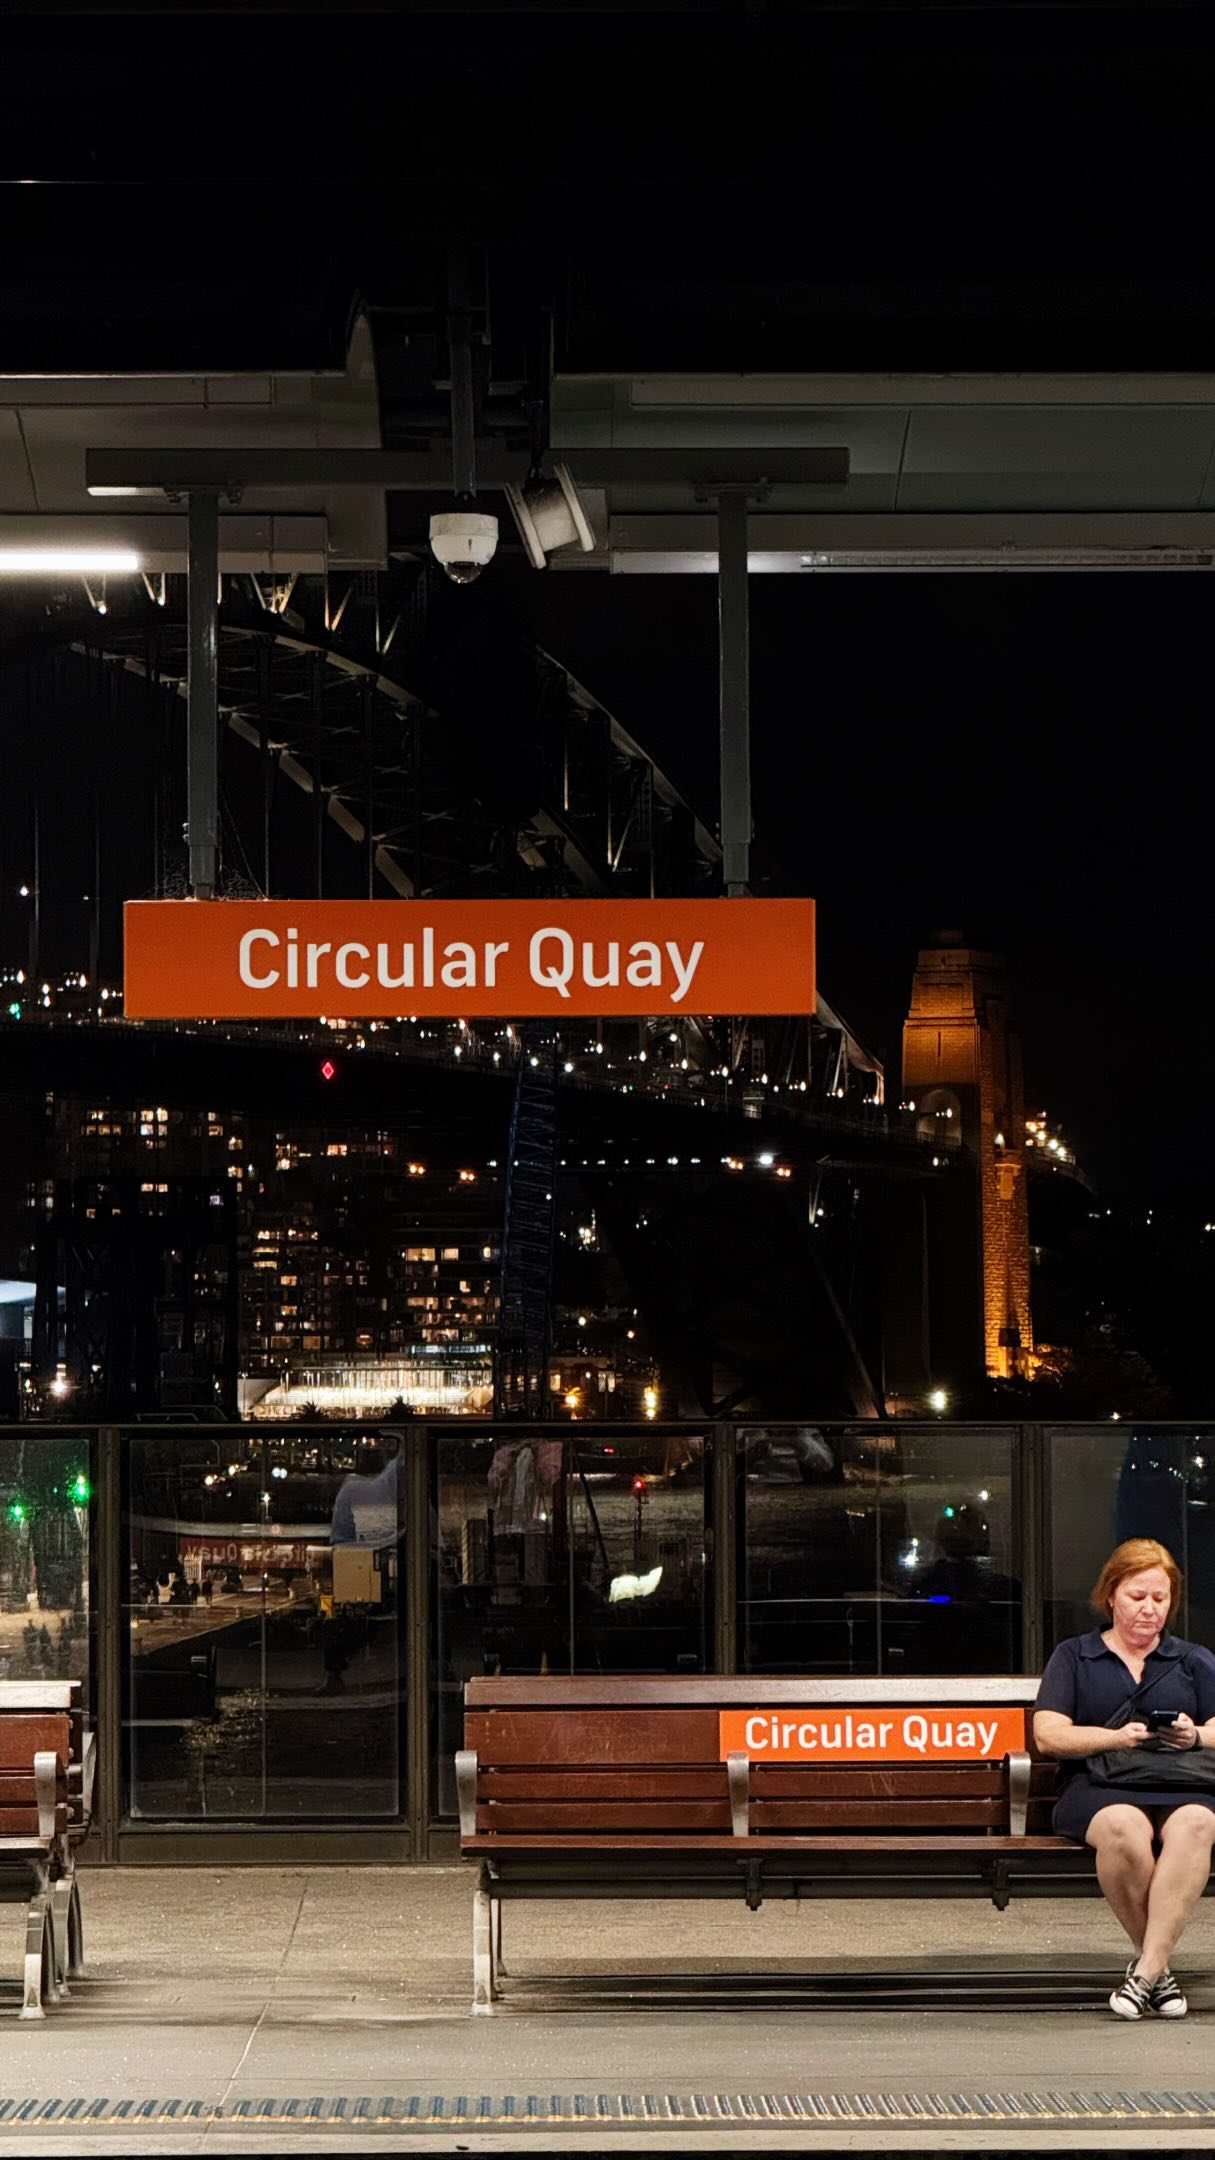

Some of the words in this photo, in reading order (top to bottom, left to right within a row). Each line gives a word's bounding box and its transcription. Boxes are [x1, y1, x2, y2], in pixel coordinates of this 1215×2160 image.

[240, 928, 508, 988] Circular
[530, 928, 704, 1002] Quay
[745, 1715, 894, 1749] Circular
[903, 1714, 999, 1755] Quay
